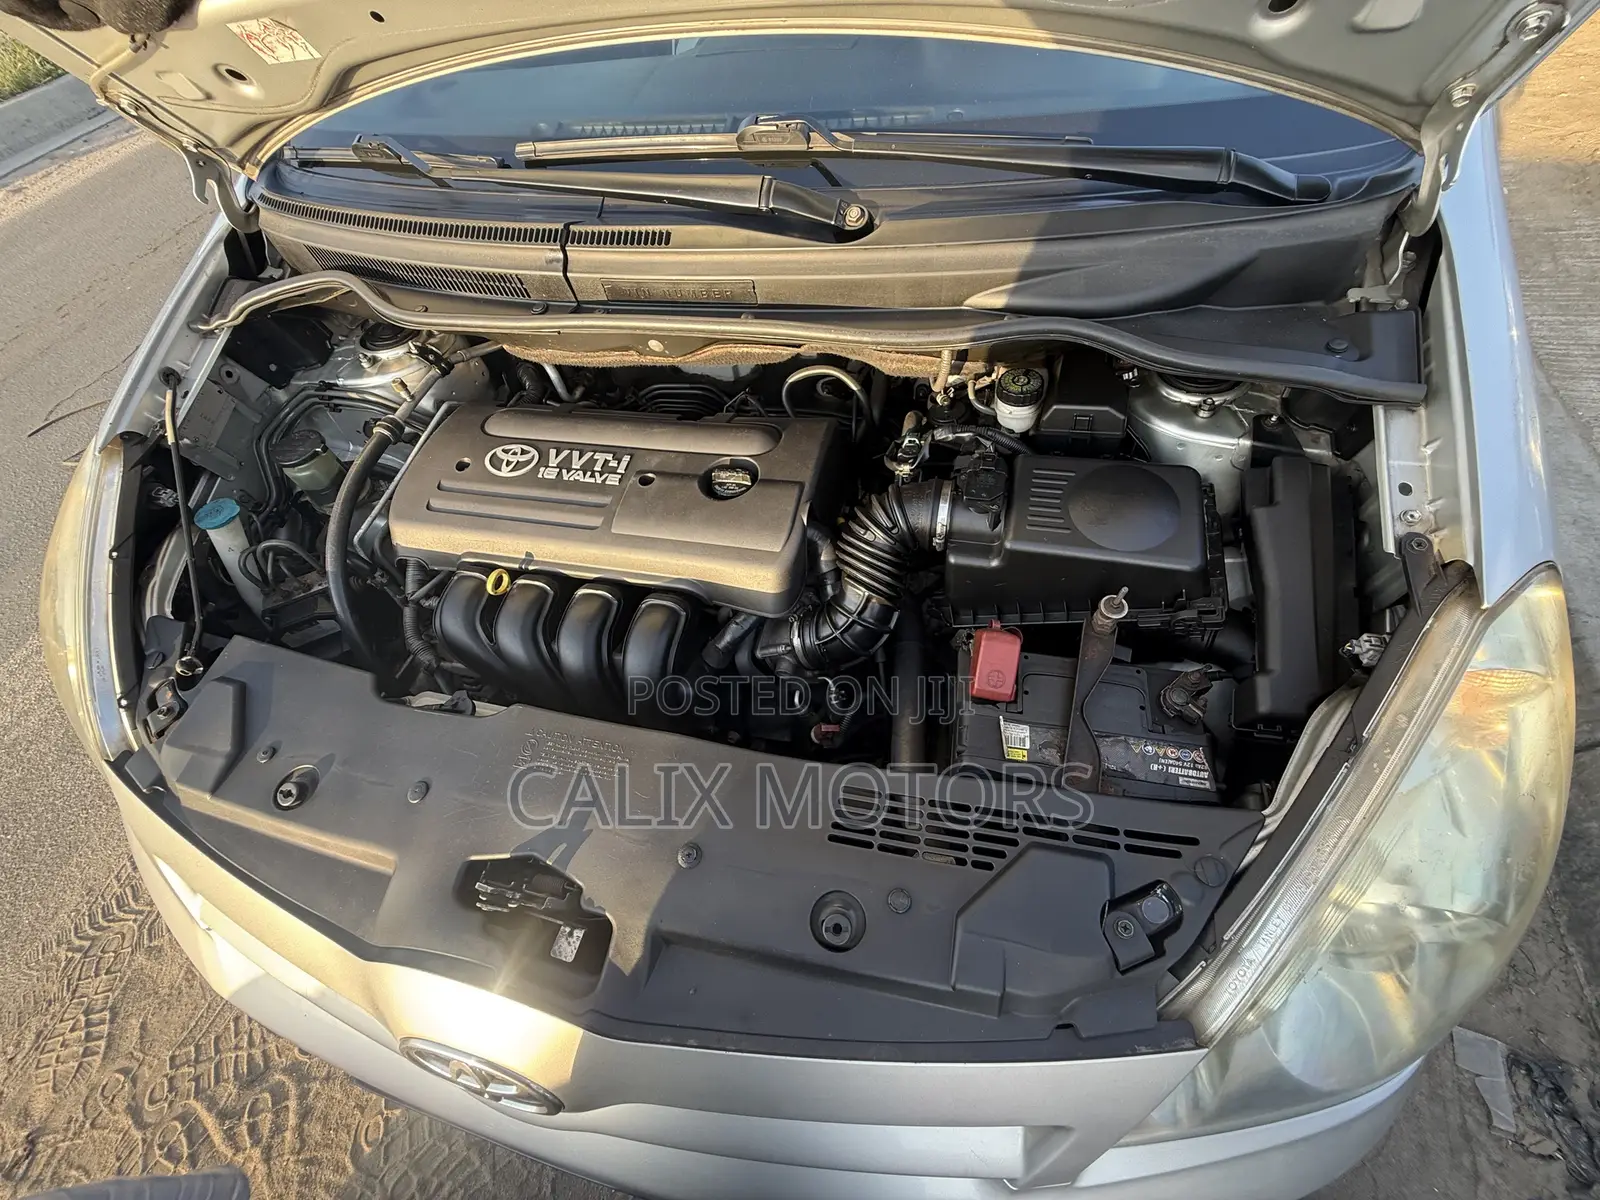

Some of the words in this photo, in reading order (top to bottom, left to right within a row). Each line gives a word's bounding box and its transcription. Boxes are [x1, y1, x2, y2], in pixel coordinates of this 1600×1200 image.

[623, 287, 652, 299] VIN
[661, 288, 733, 299] NUMBER
[537, 466, 560, 479] 16
[561, 468, 624, 486] VALVE
